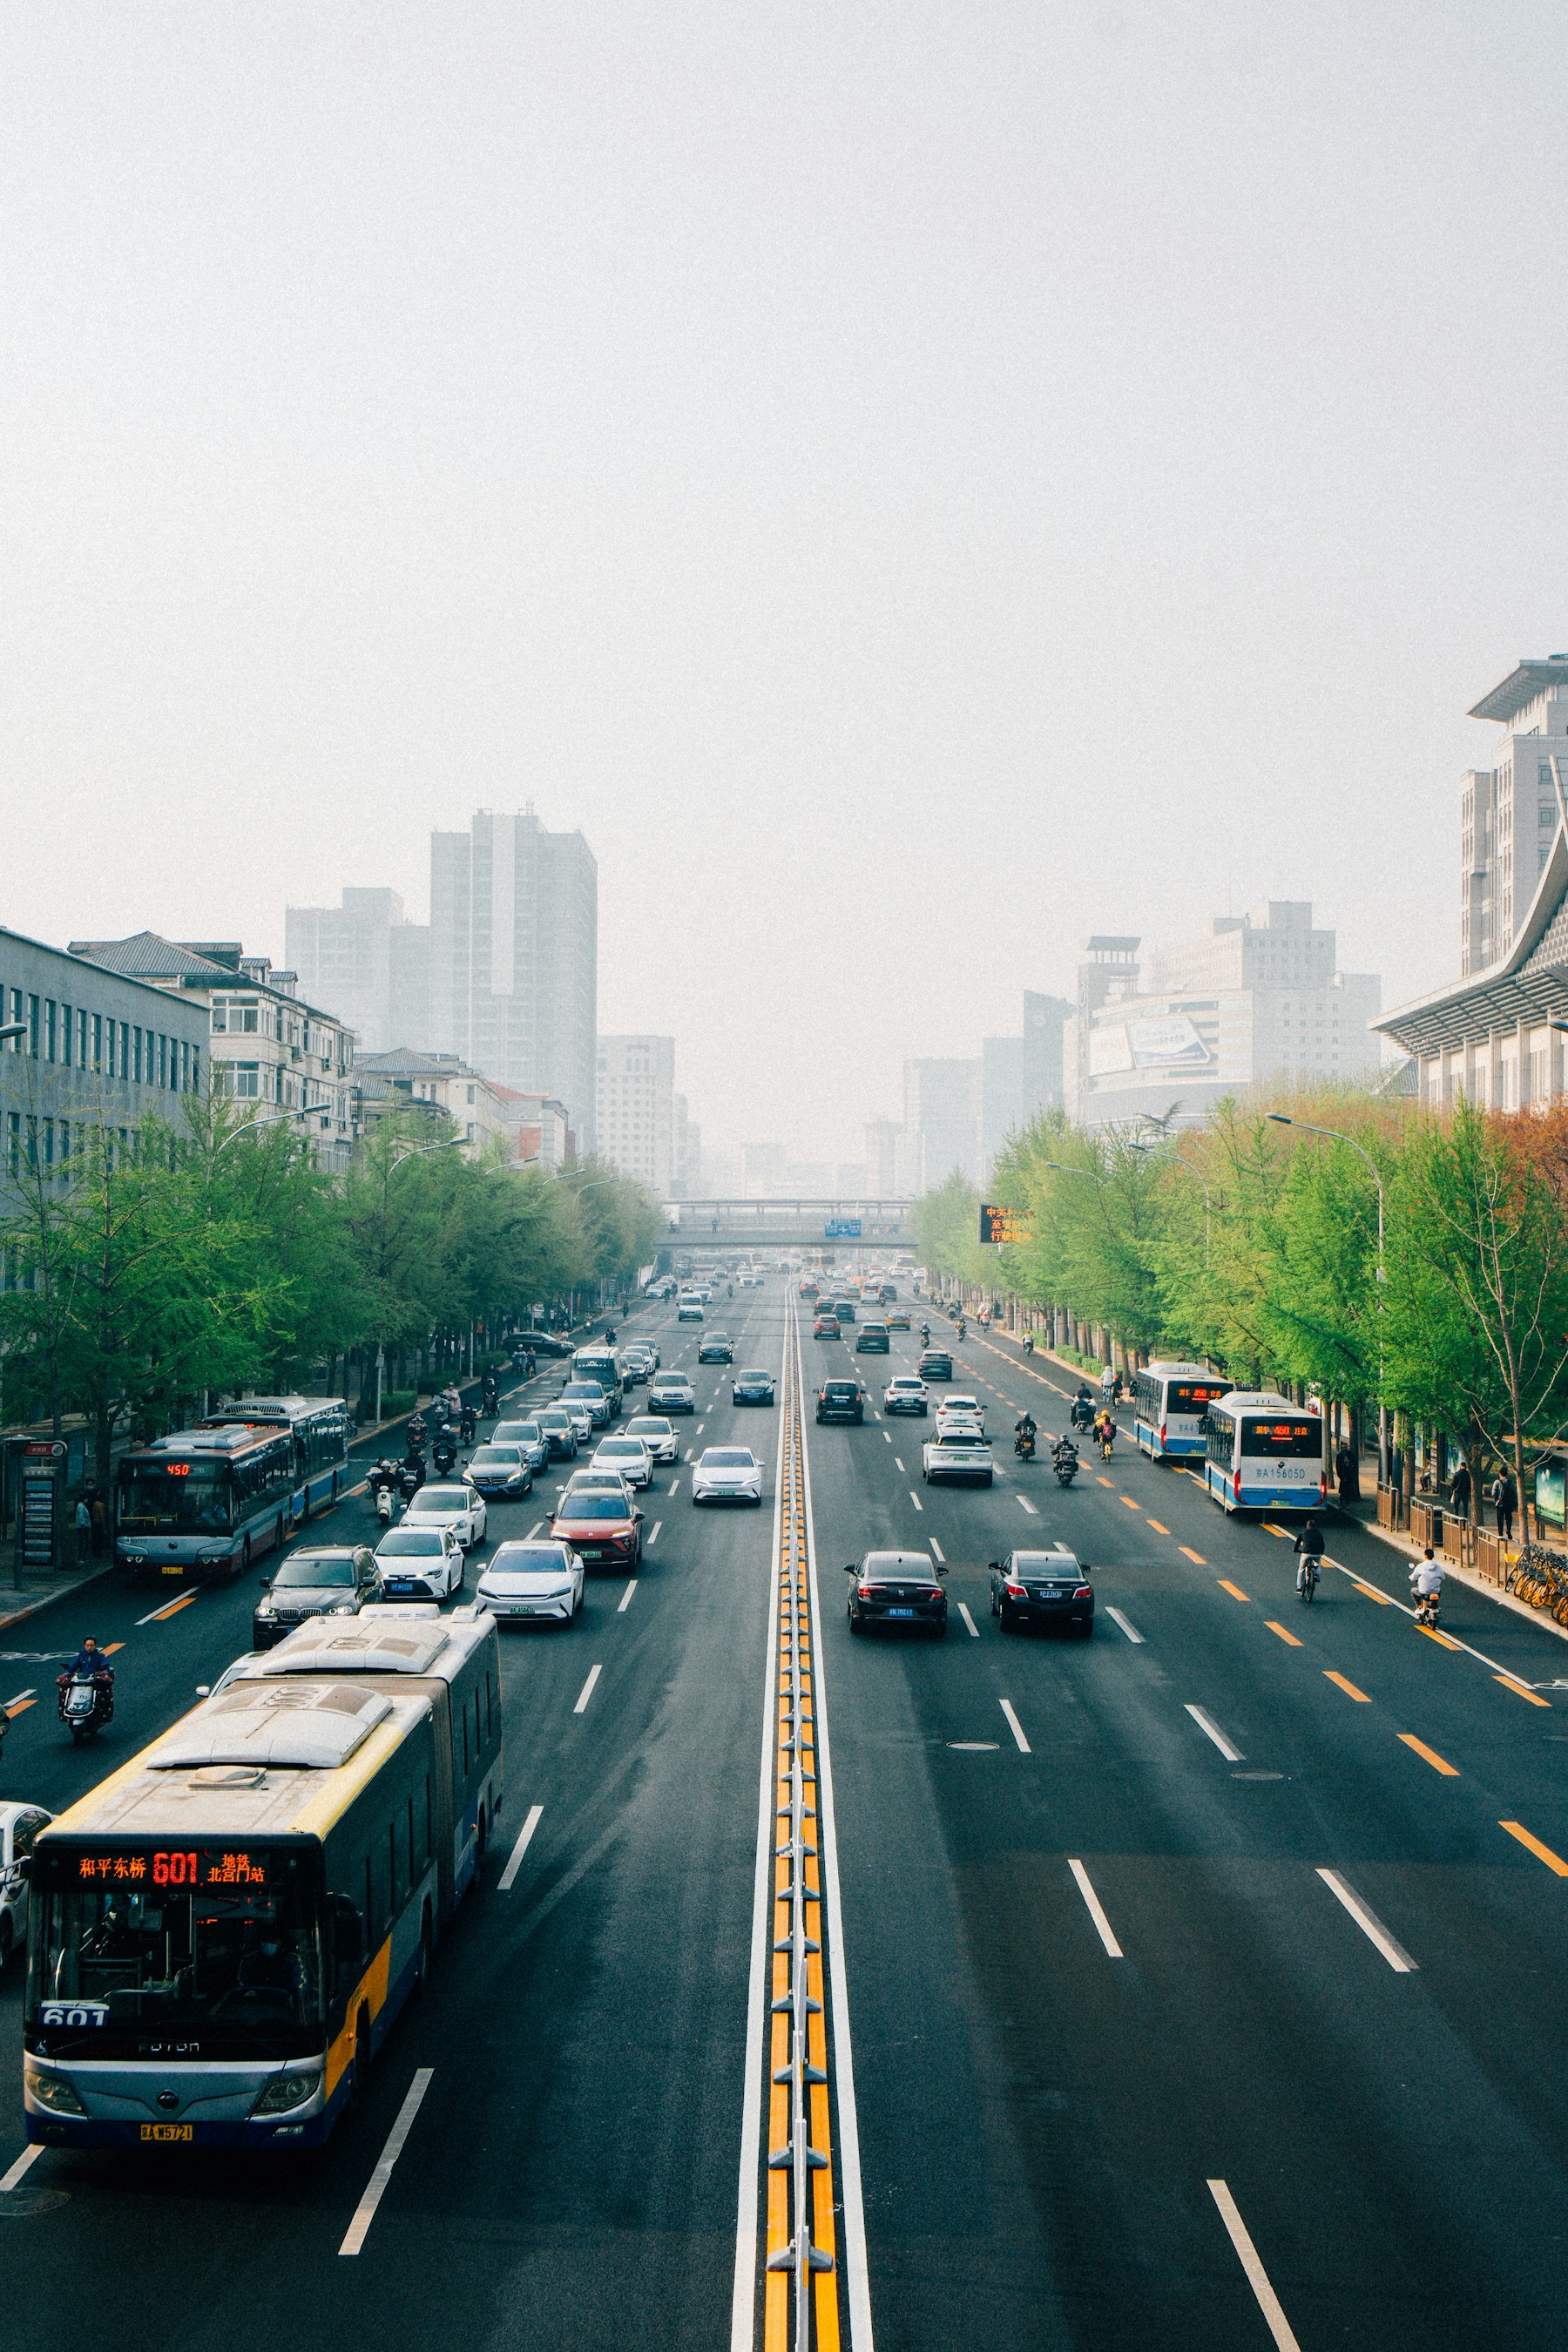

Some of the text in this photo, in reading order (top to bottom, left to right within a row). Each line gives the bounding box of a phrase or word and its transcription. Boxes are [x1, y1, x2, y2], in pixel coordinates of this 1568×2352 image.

[1193, 1389, 1207, 1397] 450
[1274, 1426, 1290, 1435] 450
[167, 1464, 190, 1476] 450
[1256, 1469, 1305, 1479] 京A15605D
[220, 1854, 250, 1869] 地铁
[79, 1853, 198, 1884] 和平东桥 601
[206, 1867, 266, 1882] 北宫门站
[44, 2008, 106, 2027] 601
